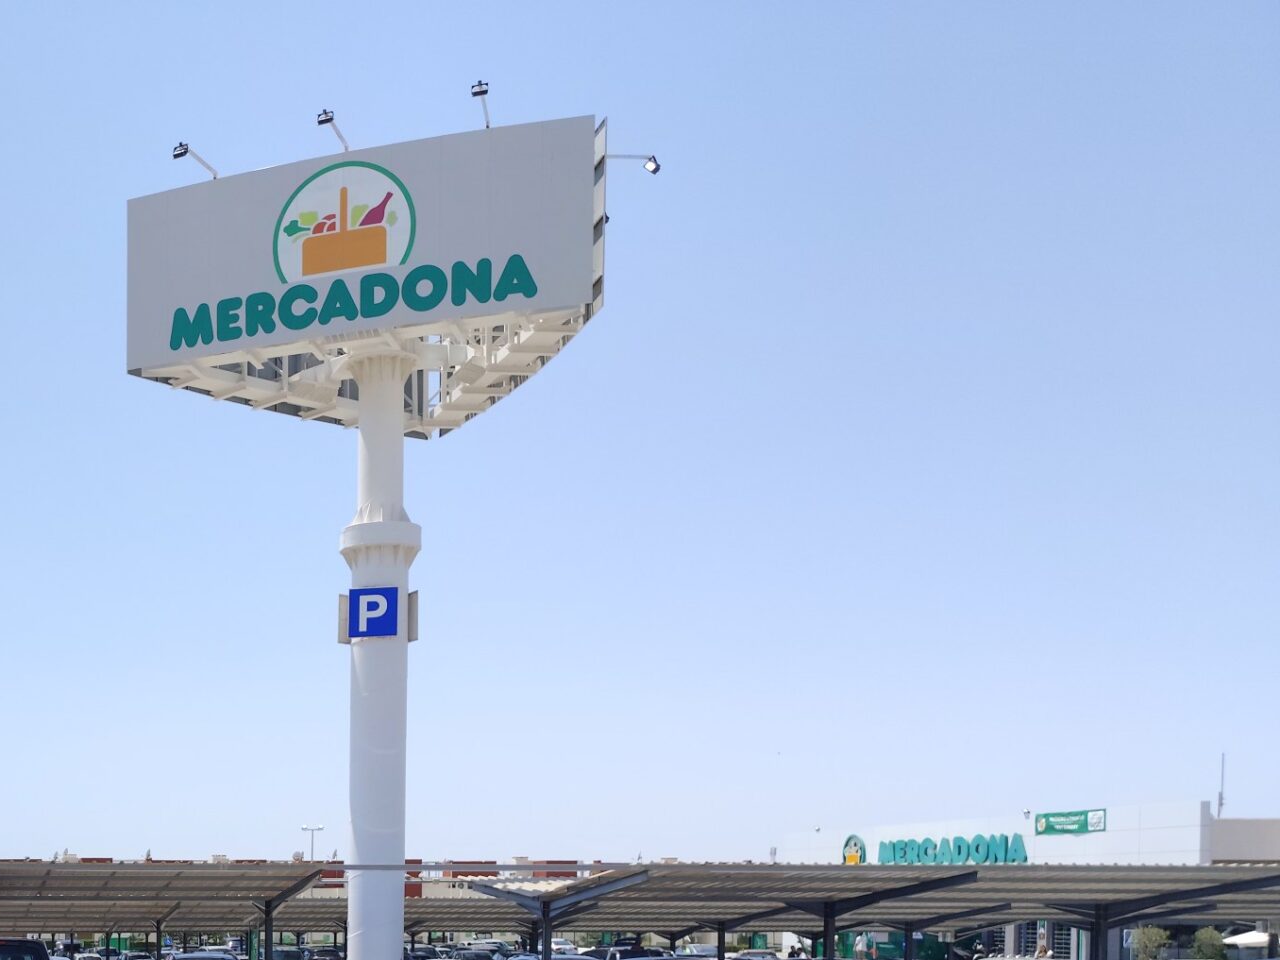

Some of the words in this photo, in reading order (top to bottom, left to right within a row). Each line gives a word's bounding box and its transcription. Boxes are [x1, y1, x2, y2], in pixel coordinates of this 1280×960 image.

[169, 253, 538, 351] MERCADONA
[358, 594, 388, 632] P
[878, 833, 1028, 865] MERCADONA
